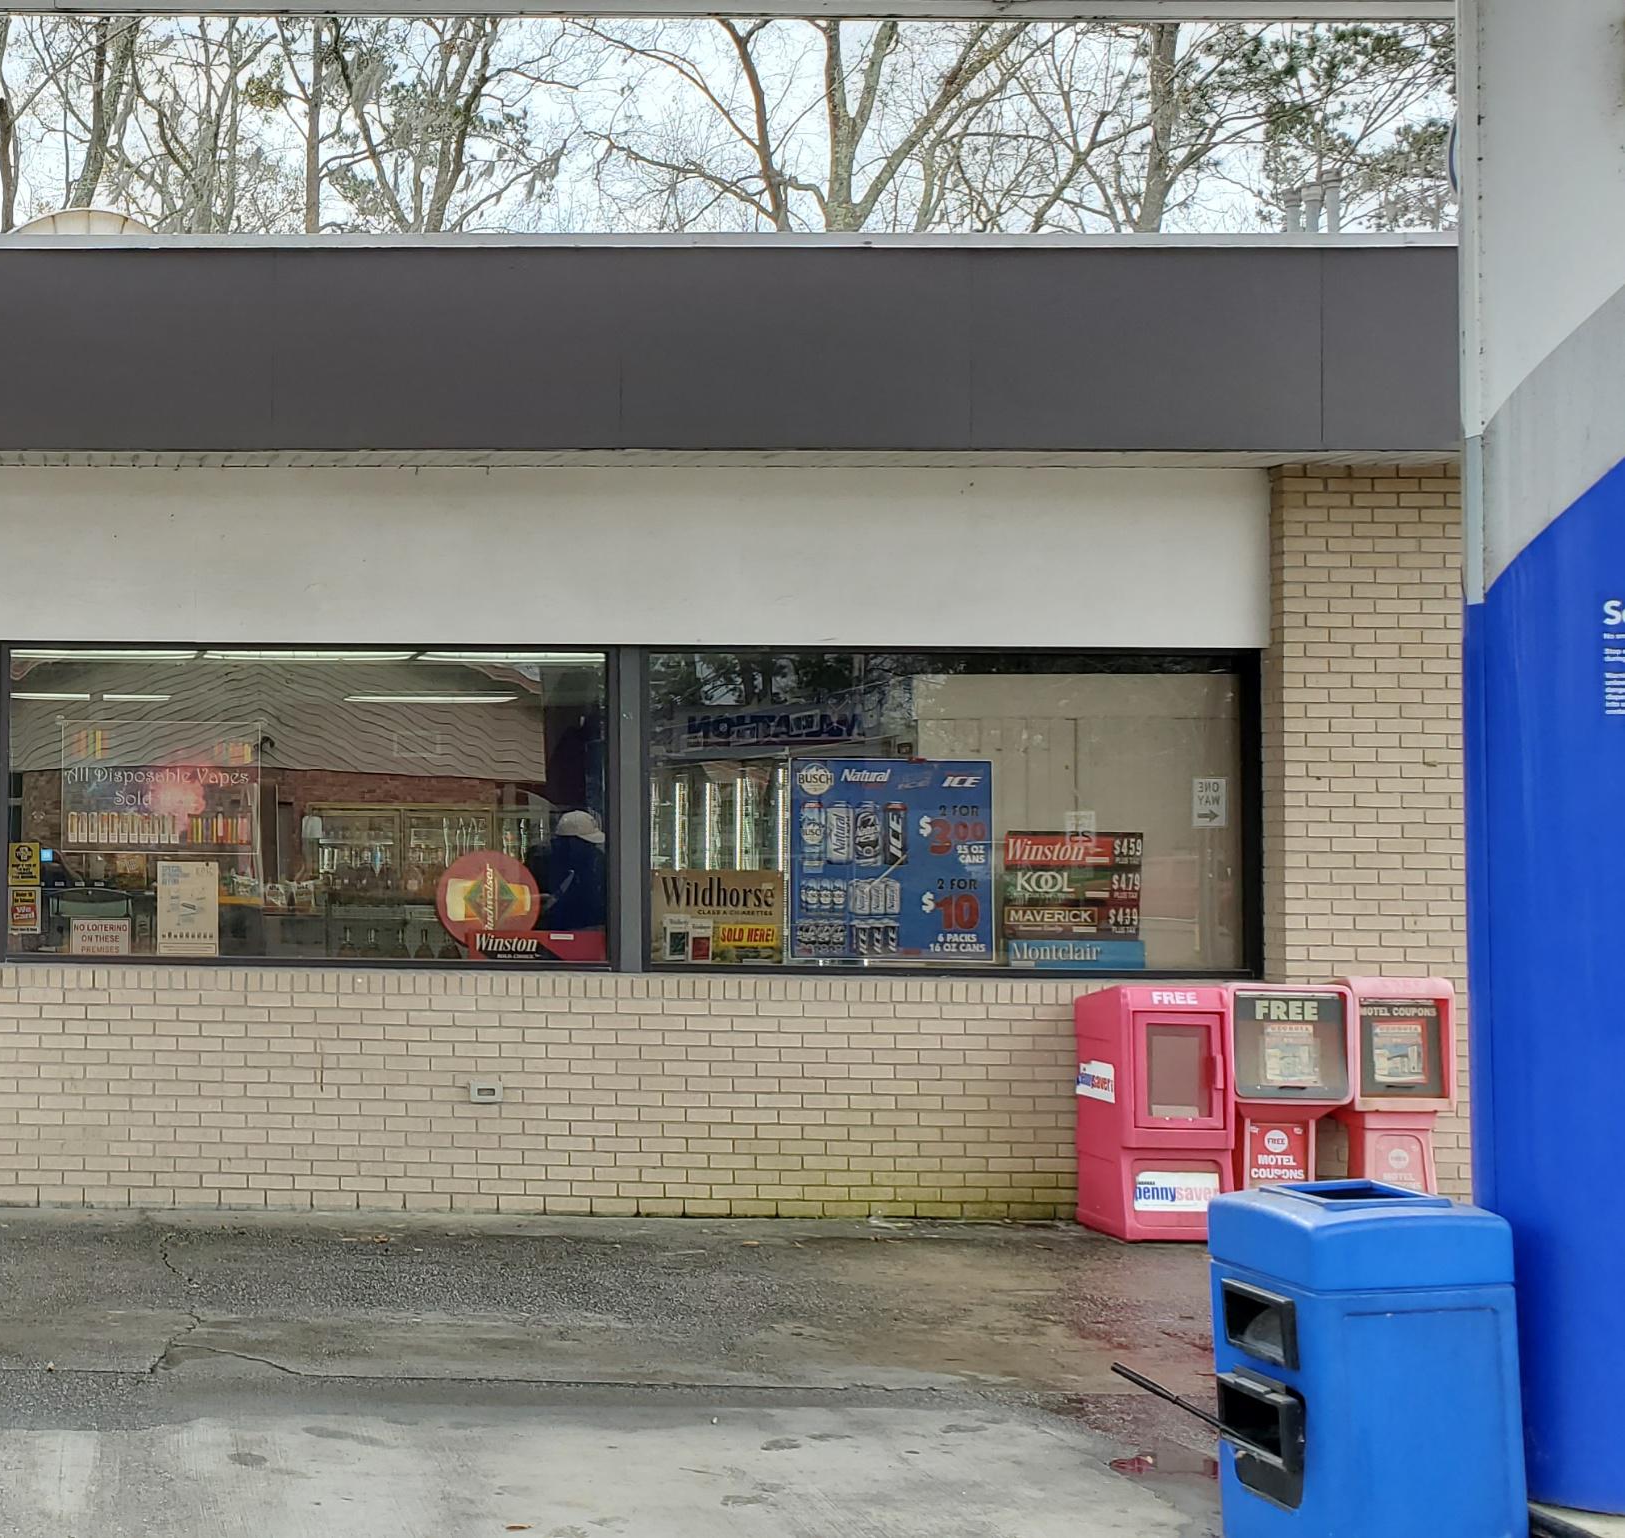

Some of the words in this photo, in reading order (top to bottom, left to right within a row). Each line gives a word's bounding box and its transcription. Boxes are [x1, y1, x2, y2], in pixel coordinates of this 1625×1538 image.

[64, 768, 89, 784] All
[94, 767, 191, 786] Disposable
[196, 768, 249, 787] Vapes
[798, 773, 833, 785] BUSCH
[841, 768, 891, 783] Natural
[942, 776, 983, 788] ICE
[113, 790, 152, 806] Sold
[939, 804, 947, 816] 2
[952, 804, 980, 817] FOR
[889, 811, 903, 858] ICE
[971, 844, 986, 854] OZ
[1007, 838, 1085, 861] Winston
[958, 854, 986, 864] CANS
[937, 878, 945, 890] 2
[950, 878, 978, 890] FOR
[1016, 871, 1075, 893] KOOL
[661, 876, 775, 908] Wildhorse
[13, 912, 35, 920] Card
[921, 890, 981, 930] $10
[1010, 910, 1093, 922] MAVERICK
[73, 923, 86, 932] NO
[87, 924, 128, 932] LOITERING
[81, 935, 93, 943] ON
[95, 935, 120, 943] THESE
[720, 927, 744, 942] SOLD
[746, 928, 775, 943] HERE!
[937, 933, 945, 942] 6
[946, 933, 977, 942] PACKS
[476, 933, 538, 952] Winston
[929, 943, 941, 952] 16
[942, 943, 957, 952] OZ
[958, 943, 986, 952] CANS
[81, 945, 120, 954] PREMISES
[1011, 941, 1101, 960] Montclair
[1152, 991, 1198, 1005] FREE
[1255, 1000, 1319, 1021] FREE
[1392, 1007, 1437, 1017] COUPONS
[1267, 1137, 1285, 1145] FREE
[1258, 1154, 1297, 1166] MOTEL
[1251, 1168, 1305, 1180] COUPONS
